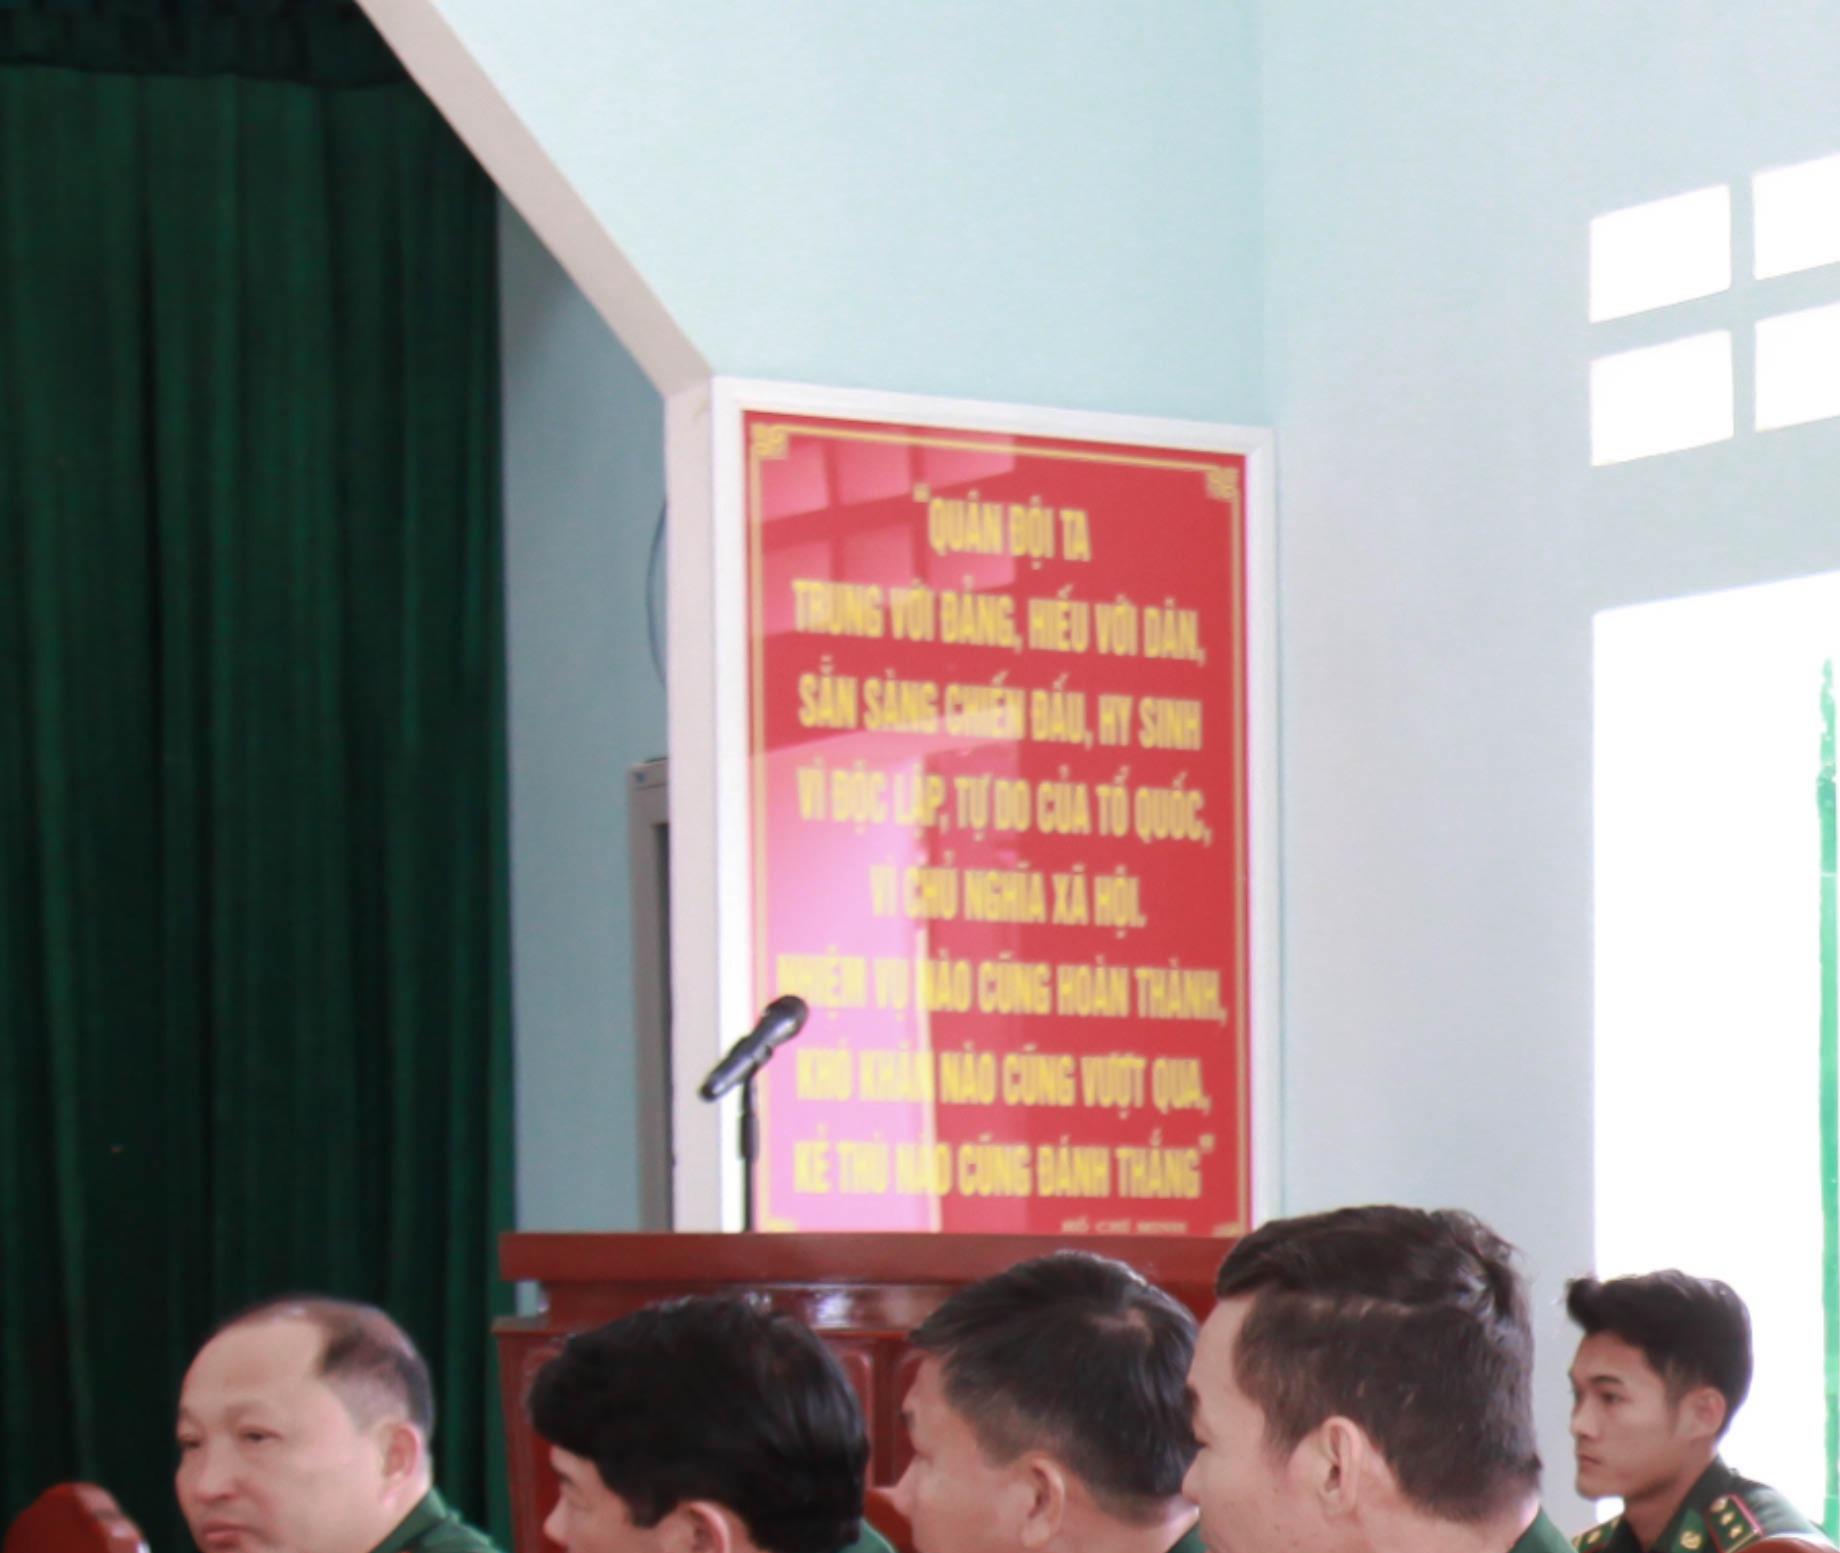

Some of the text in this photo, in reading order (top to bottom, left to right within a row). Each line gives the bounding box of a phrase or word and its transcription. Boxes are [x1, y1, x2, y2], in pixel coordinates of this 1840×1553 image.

[1060, 509, 1091, 561] TA
[792, 578, 885, 638] TRUNG
[1097, 693, 1133, 747] HY
[1139, 697, 1203, 751] SINH
[994, 778, 1032, 832] DO
